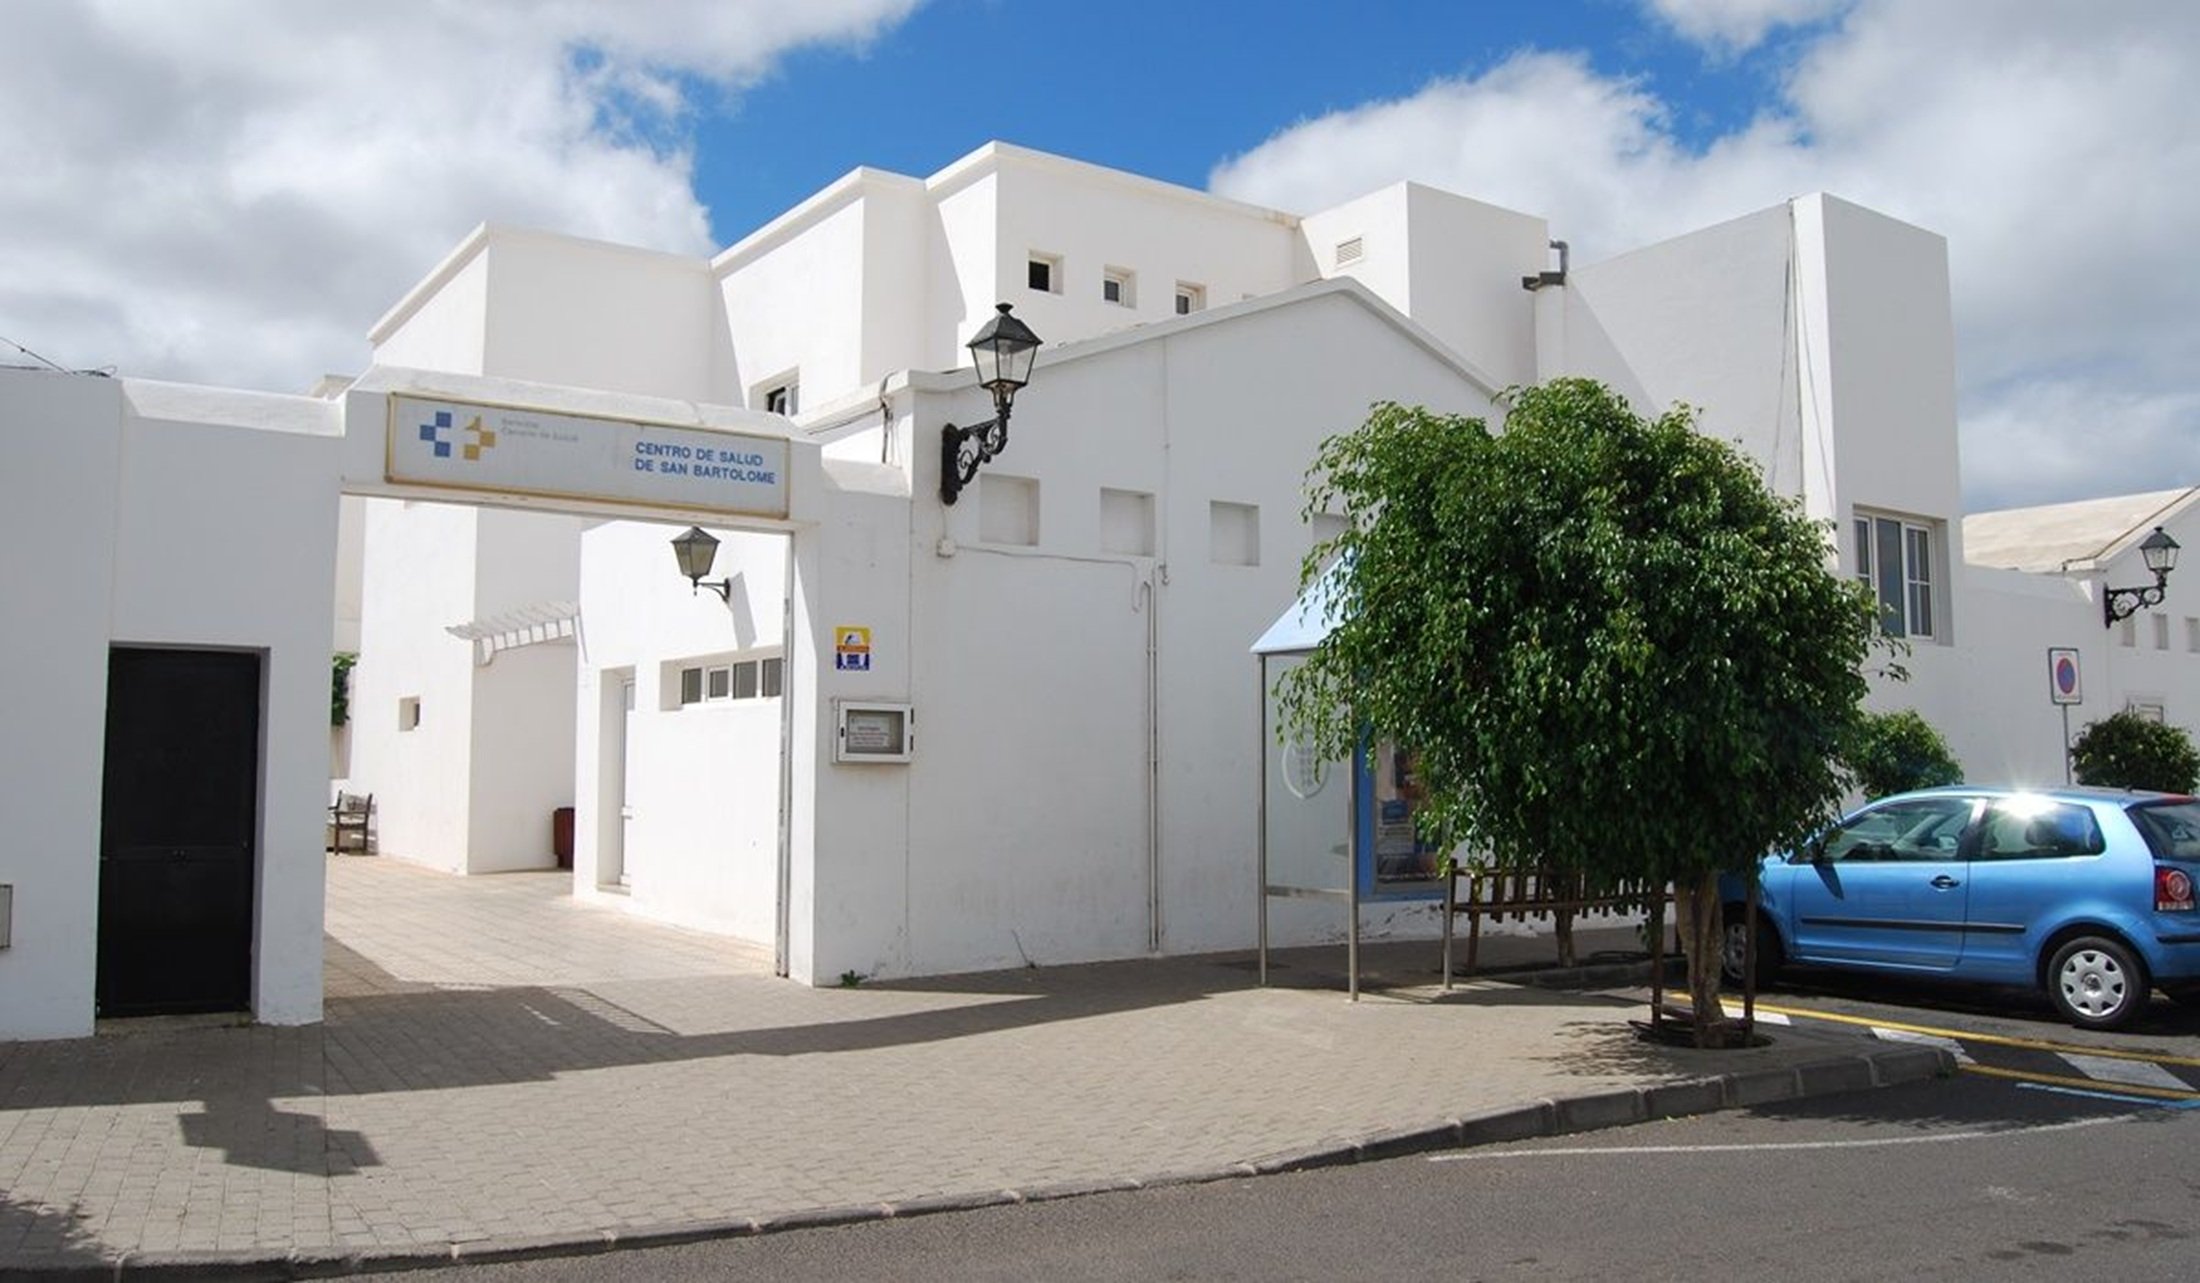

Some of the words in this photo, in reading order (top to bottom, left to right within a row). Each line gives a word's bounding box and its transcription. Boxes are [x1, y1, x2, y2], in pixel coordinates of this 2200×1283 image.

[636, 442, 691, 459] CENTRO
[696, 448, 714, 461] DE
[719, 451, 764, 467] SALUD
[635, 458, 654, 472] DE
[660, 461, 688, 475] SAN
[693, 465, 776, 485] BARTOLOME
